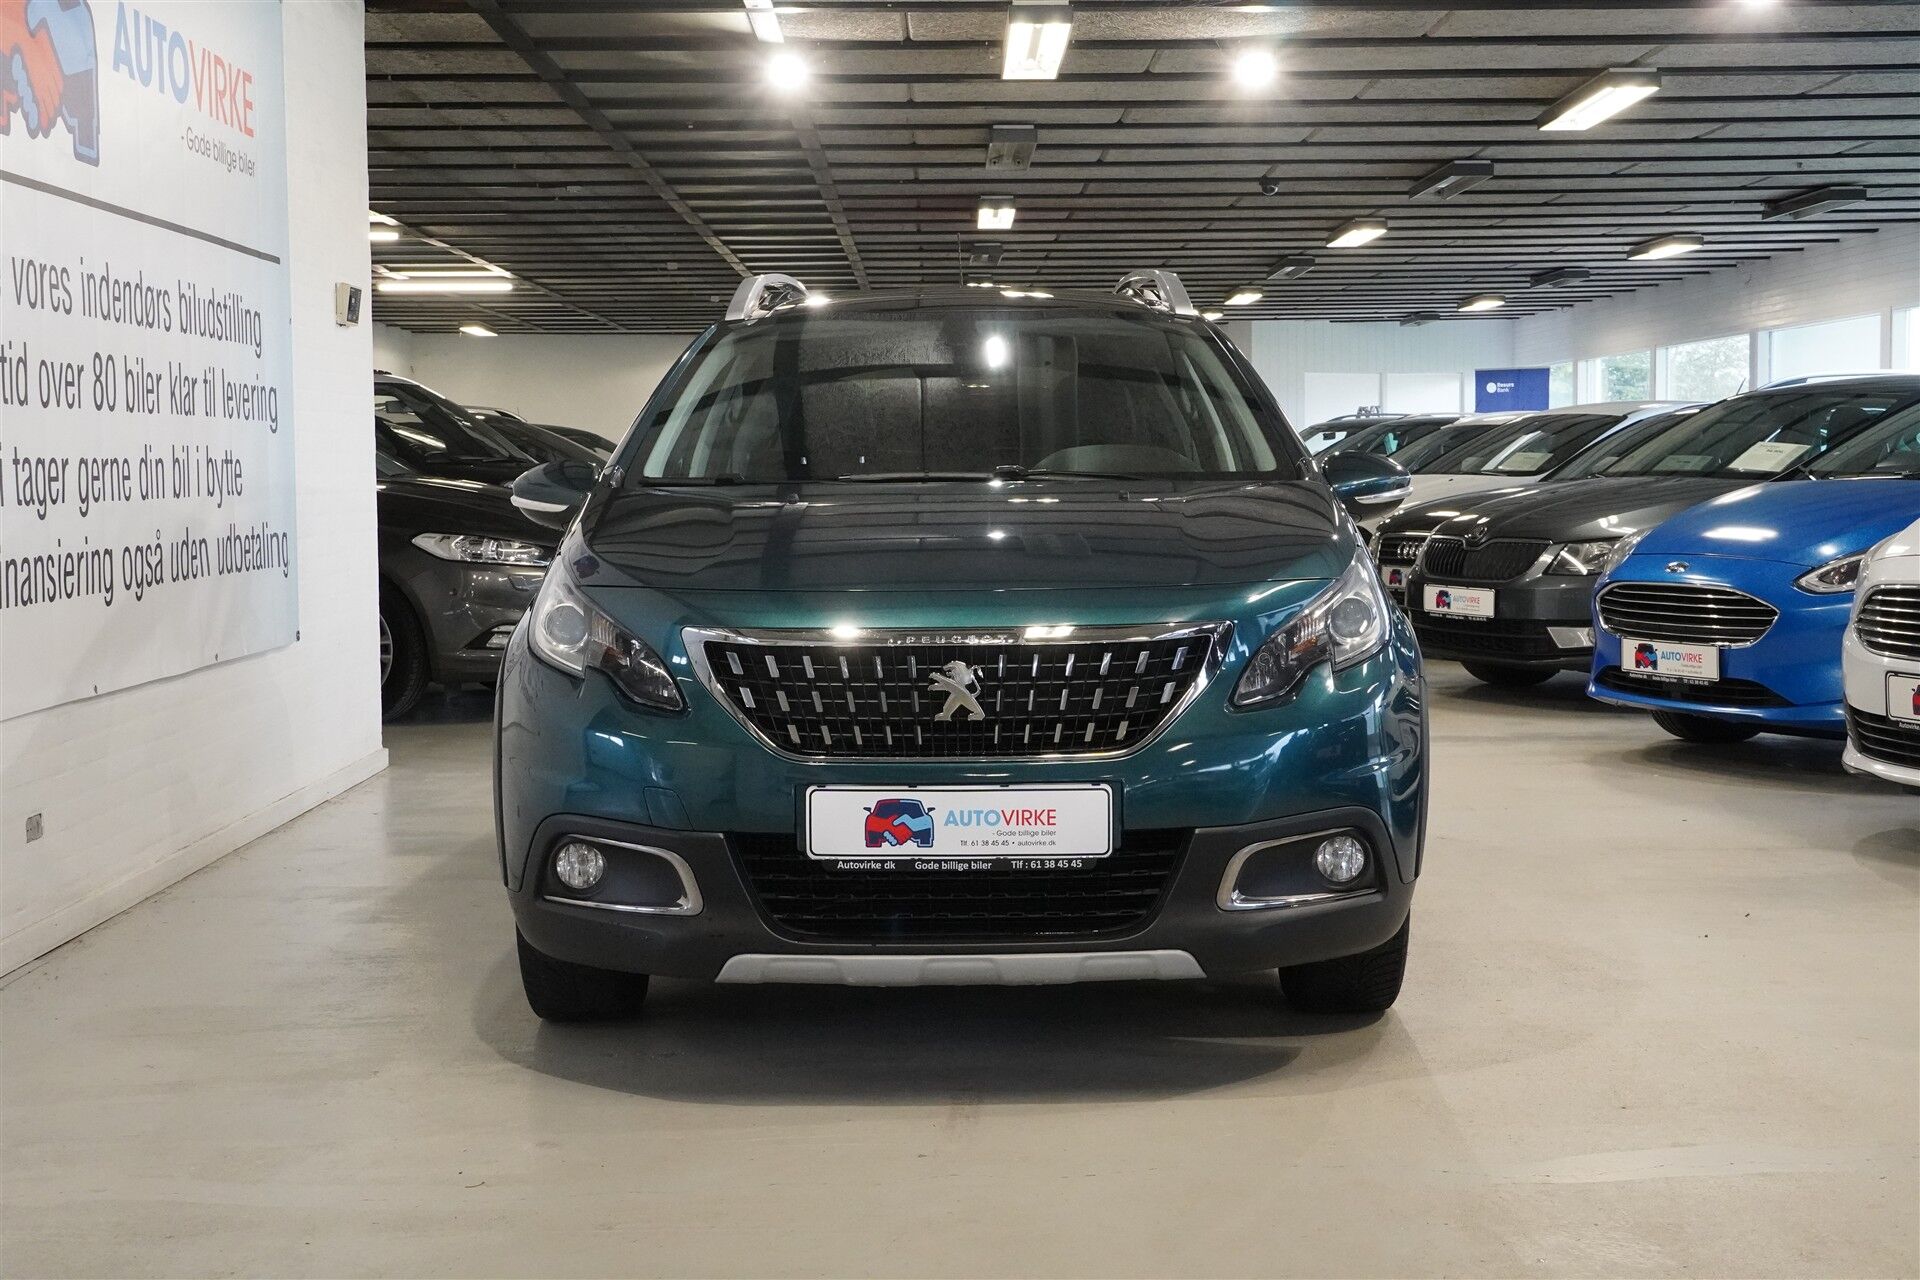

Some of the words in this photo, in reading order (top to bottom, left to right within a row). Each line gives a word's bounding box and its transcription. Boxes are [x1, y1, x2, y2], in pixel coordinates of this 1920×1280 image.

[112, 0, 255, 138] AUTOVIRKE
[186, 126, 211, 158] Gode
[212, 138, 237, 173] billige
[238, 150, 255, 178] biler
[12, 256, 73, 316] vores
[80, 256, 172, 333] indendørs
[178, 280, 262, 359] biludstilling
[39, 359, 85, 409] over
[93, 351, 117, 412] 80
[124, 355, 163, 415] biler
[169, 361, 199, 417] klar
[203, 366, 217, 418] til
[222, 368, 279, 434] levering
[13, 446, 69, 521] tager
[78, 455, 132, 517] gerne
[139, 444, 165, 501] din
[173, 445, 191, 500] bil
[196, 445, 201, 498] i
[206, 445, 243, 509] bytte
[122, 528, 165, 602] også
[171, 526, 211, 584] uden
[217, 521, 289, 579] udbetaling
[1660, 651, 1703, 664] AUTOVIRKE
[944, 808, 1057, 827] AUTOVIRKE
[971, 839, 979, 847] 61
[981, 839, 990, 847] 38
[991, 839, 1000, 847] 45
[1001, 839, 1010, 847] 45
[996, 829, 1017, 837] Gode
[1018, 829, 1039, 839] billige
[1041, 829, 1057, 837] biler
[837, 861, 882, 871] Autovirke
[884, 860, 896, 870] dk
[914, 861, 940, 871] Gode
[941, 860, 969, 873] billige
[971, 860, 992, 871] biler
[1011, 859, 1024, 869] Tlf
[1030, 860, 1042, 869] 61
[1044, 860, 1056, 869] 38
[1057, 860, 1069, 869] 45
[1070, 860, 1083, 869] 45
